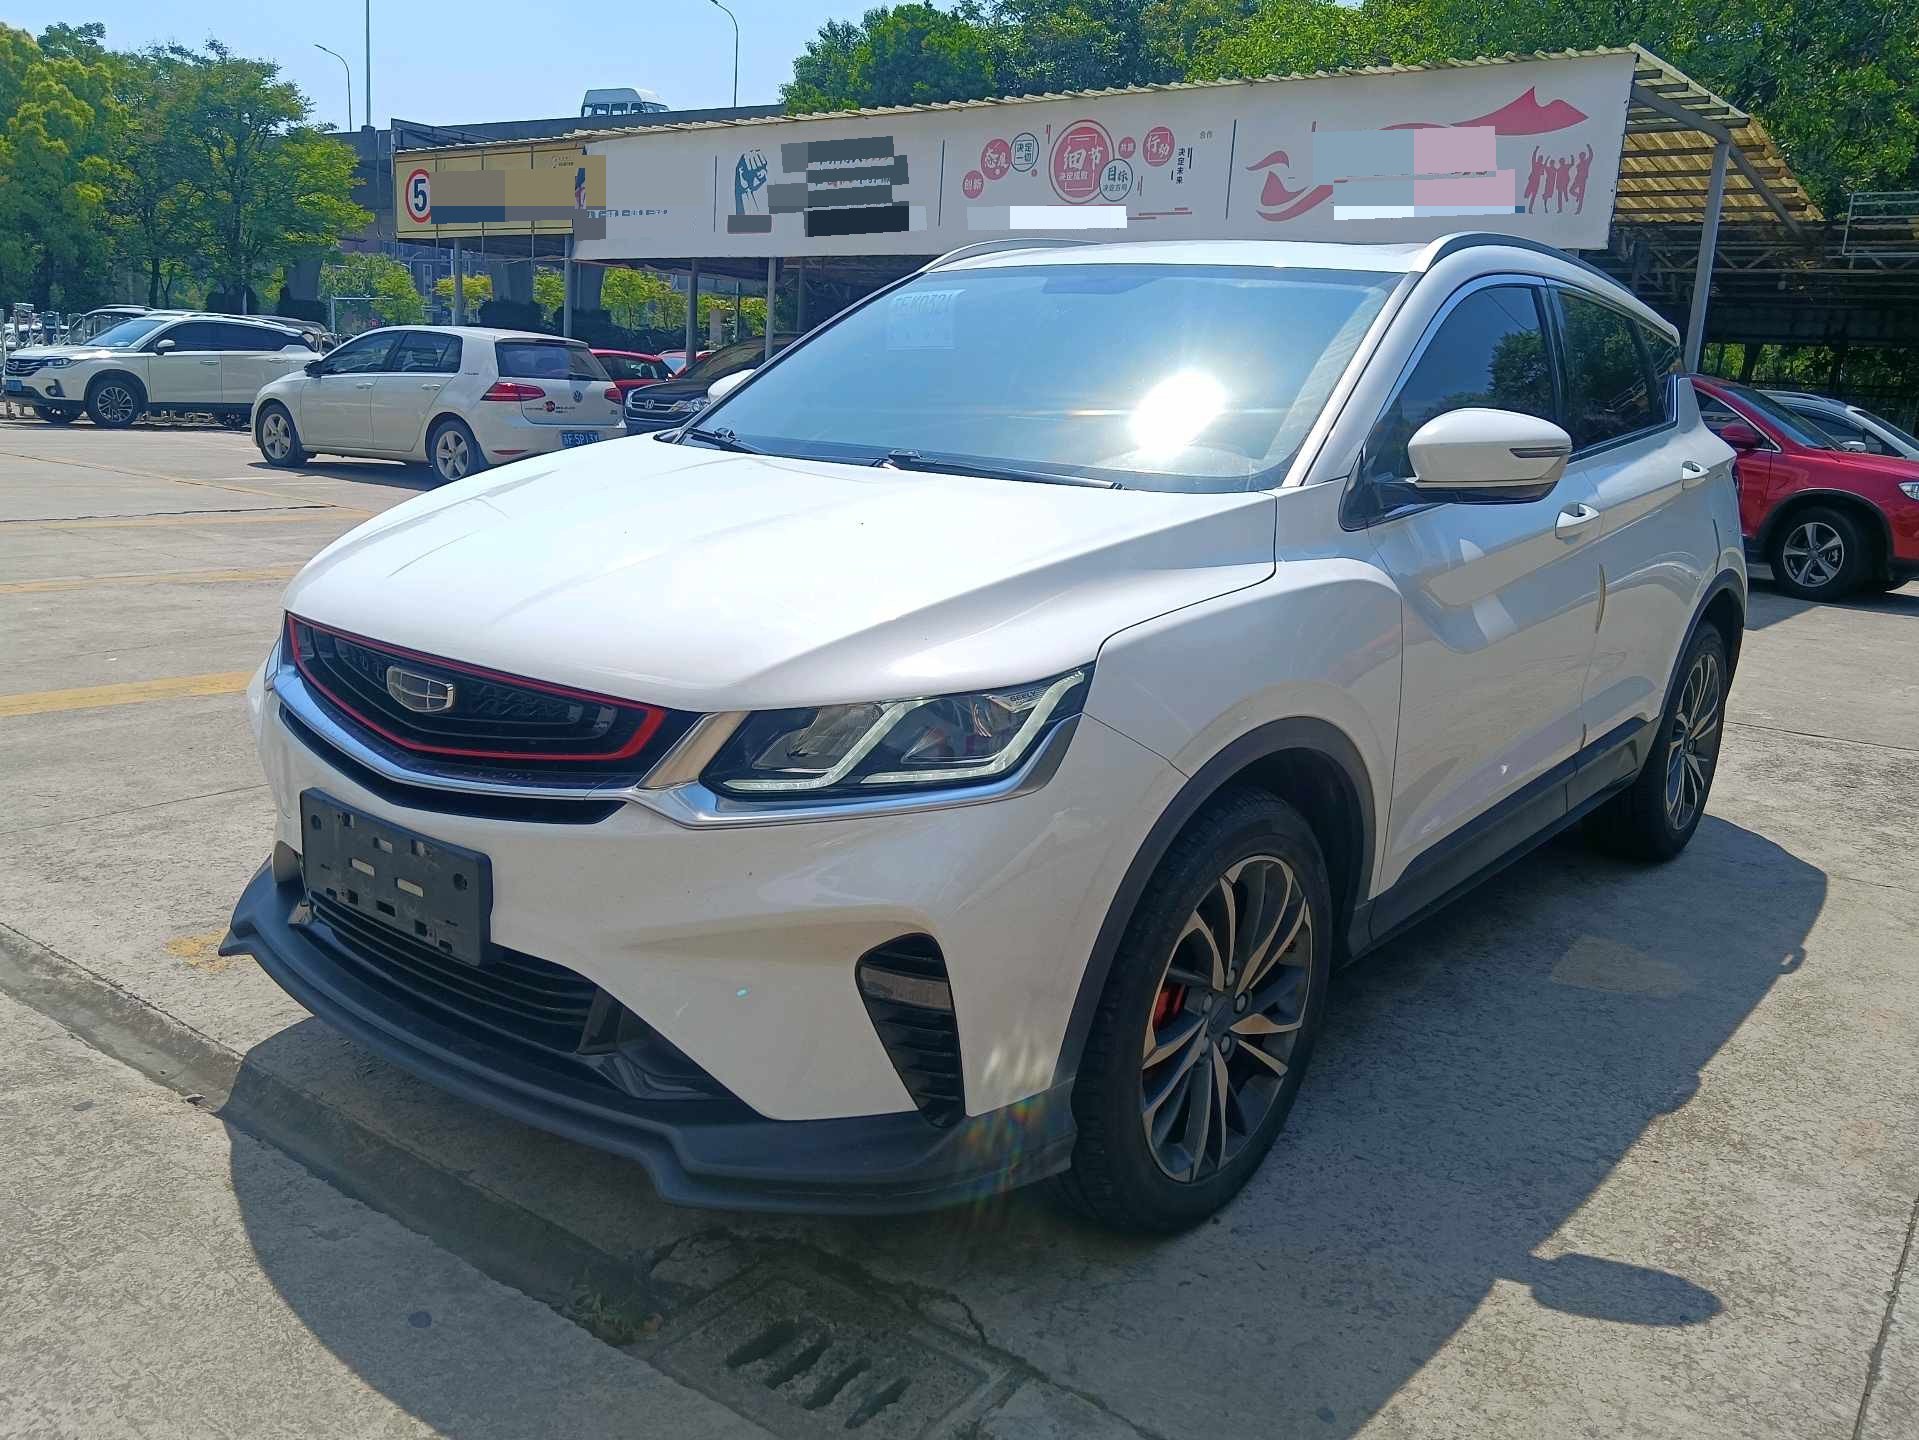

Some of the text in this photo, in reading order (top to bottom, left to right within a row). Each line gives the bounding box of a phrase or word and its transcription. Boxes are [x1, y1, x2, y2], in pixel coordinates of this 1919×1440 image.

[1063, 144, 1104, 170] 细节
[1176, 147, 1186, 185] 决定未来
[1107, 165, 1129, 183] 目标
[413, 178, 428, 212] 5
